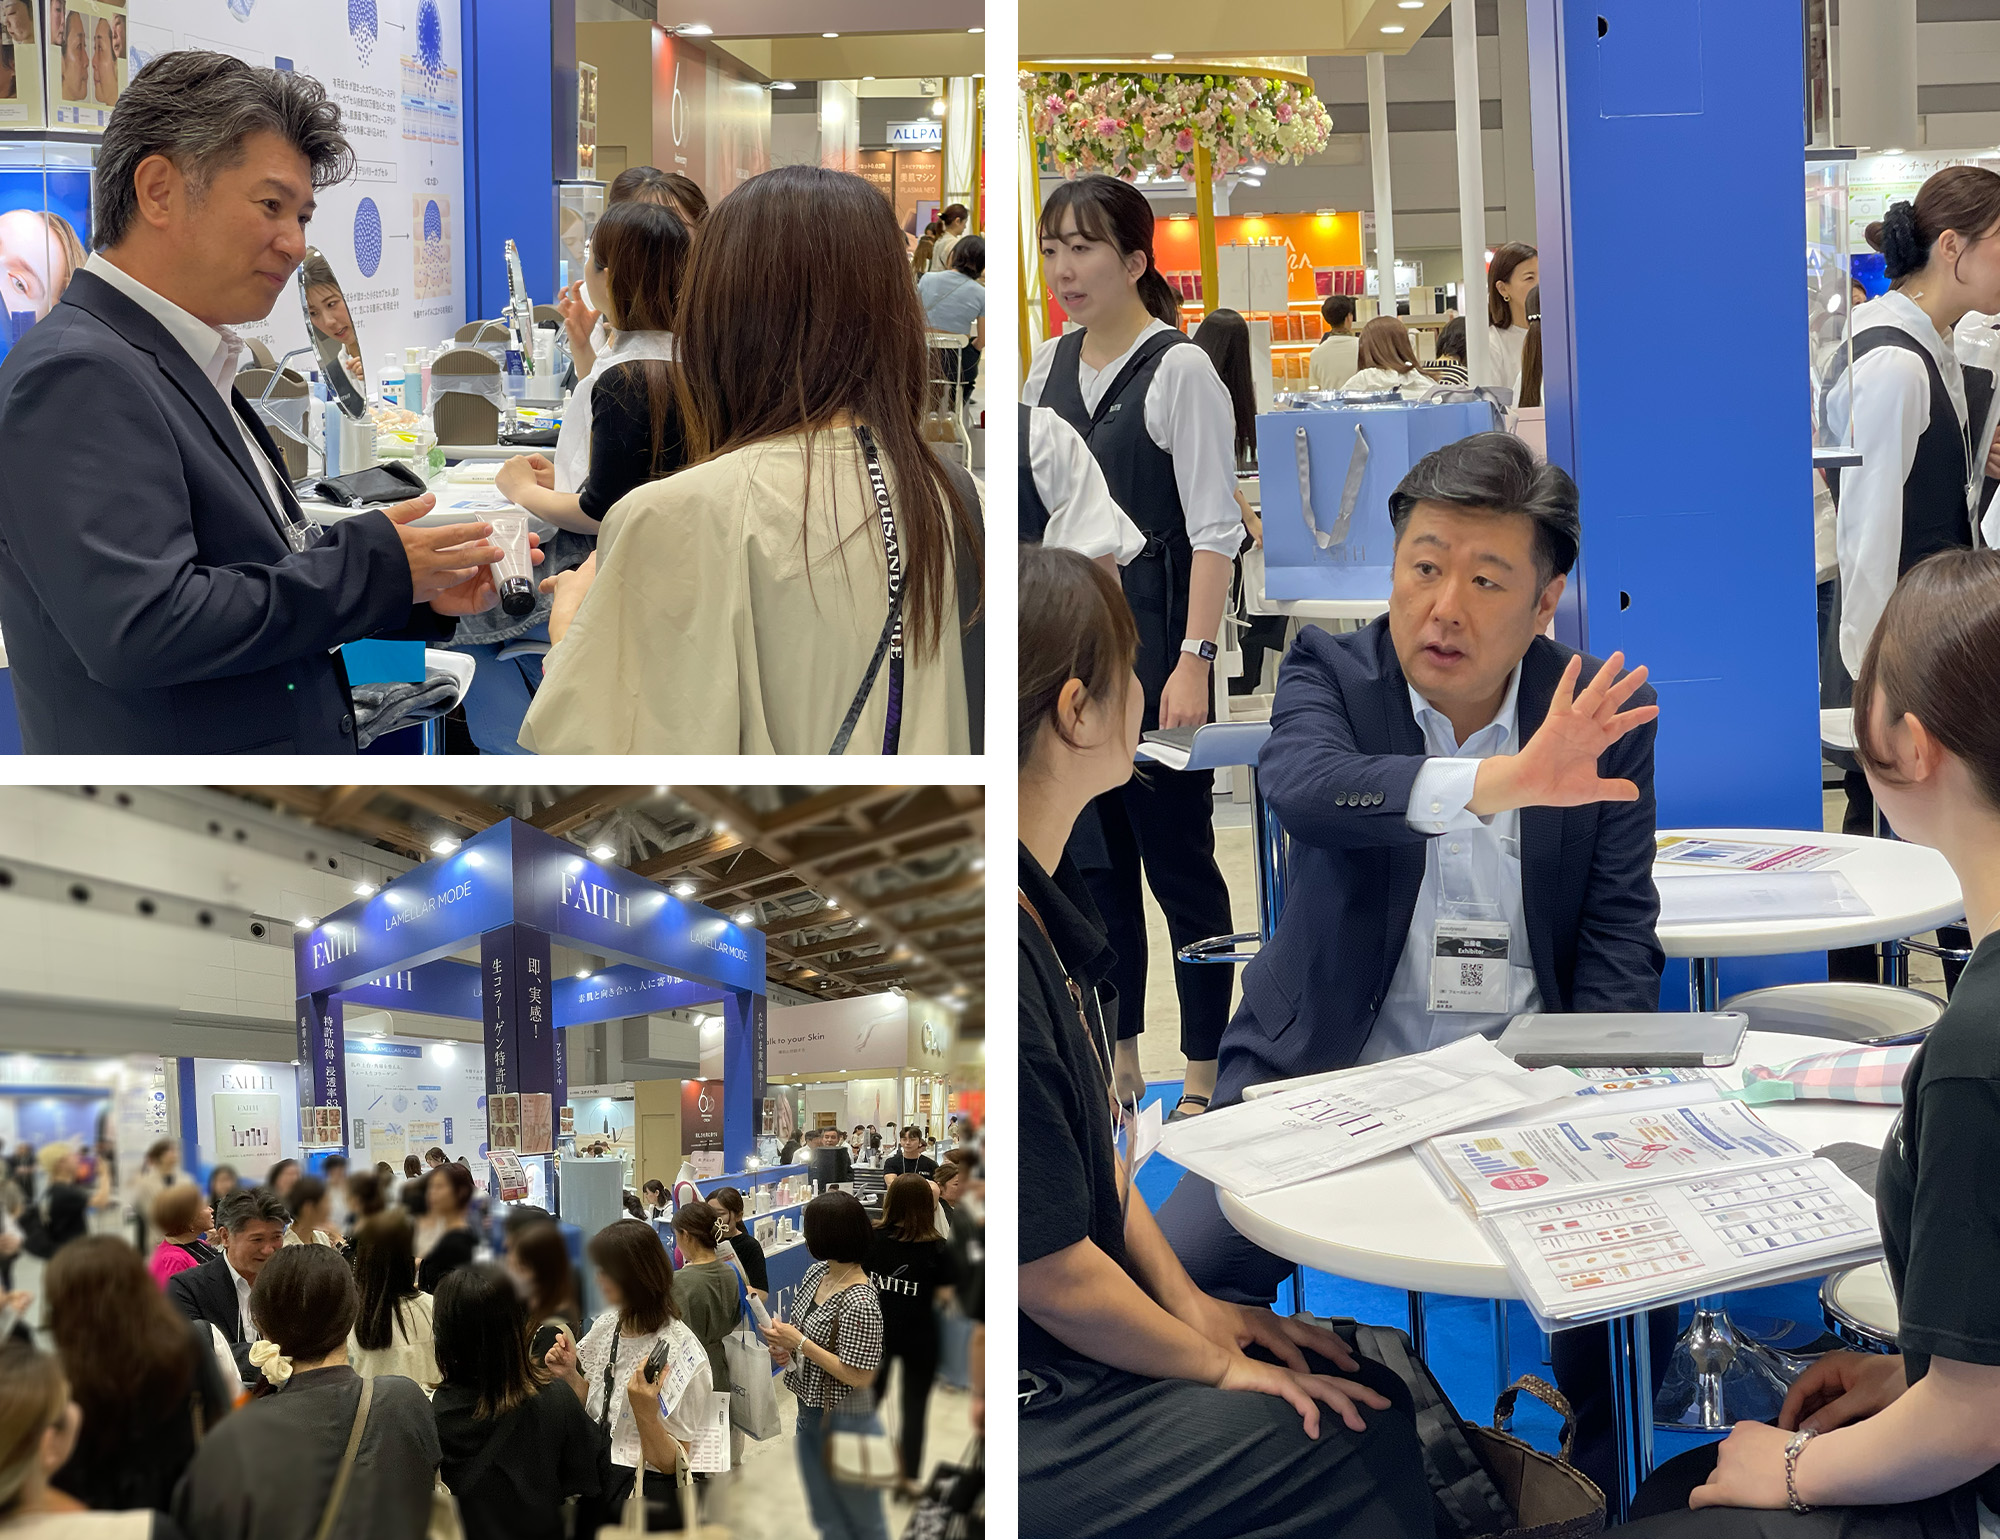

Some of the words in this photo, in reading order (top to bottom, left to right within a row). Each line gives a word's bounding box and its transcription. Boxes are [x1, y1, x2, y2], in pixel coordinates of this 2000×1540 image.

[866, 457, 901, 593] THOUSAND
[384, 896, 437, 932] LAMELLAR
[437, 880, 473, 910] MODE
[560, 871, 632, 927] FAITH
[312, 926, 358, 970] FAITH
[689, 930, 730, 956] LAMELLAR
[728, 945, 749, 962] MODE
[1457, 947, 1485, 955] Exhibitor
[578, 974, 690, 1004] 素肌と向き合い、人に寄り添
[491, 957, 507, 1095] 生コラーゲン特許取
[766, 1036, 777, 1046] alk
[777, 1037, 786, 1045] to
[786, 1034, 806, 1046] your
[807, 1032, 826, 1042] Skin
[221, 1074, 274, 1090] FAITH
[870, 1271, 918, 1297] FAITH
